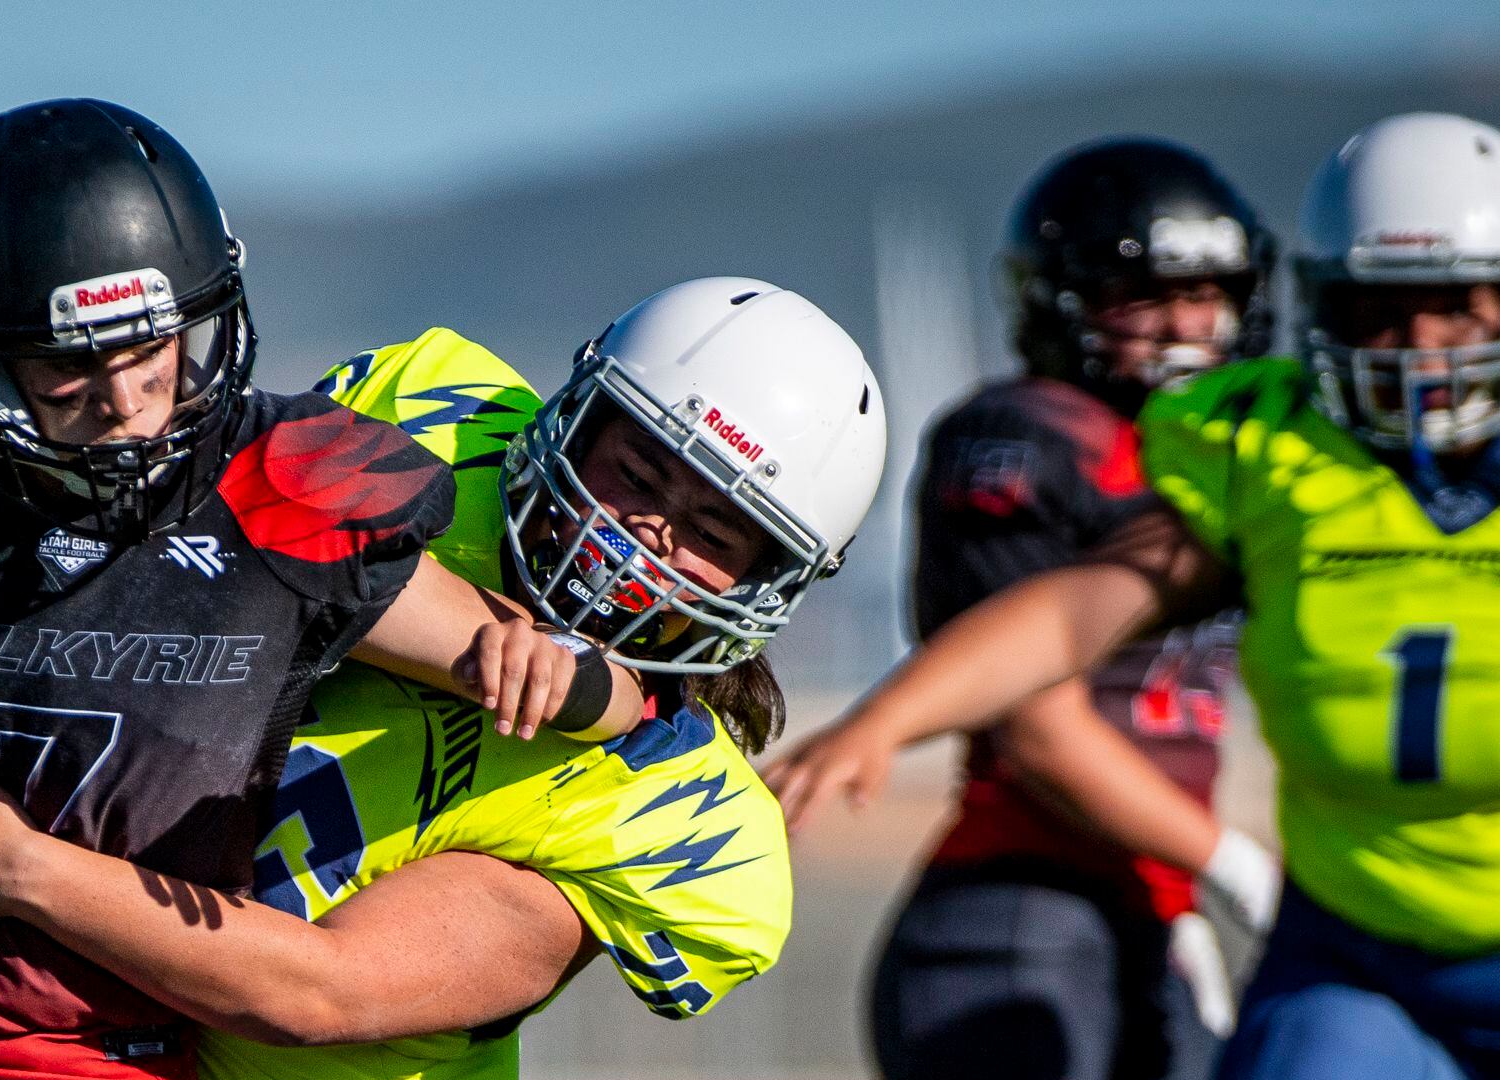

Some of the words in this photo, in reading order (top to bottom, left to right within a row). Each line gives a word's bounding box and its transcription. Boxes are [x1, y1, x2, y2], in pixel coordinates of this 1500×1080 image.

[75, 276, 145, 307] Riddell
[703, 407, 764, 462] Riddell
[38, 546, 66, 555] TACKLE
[66, 549, 106, 559] FOOTBALL
[40, 537, 70, 549] UTAH
[71, 537, 107, 551] GIRLS
[571, 582, 609, 613] BATLE
